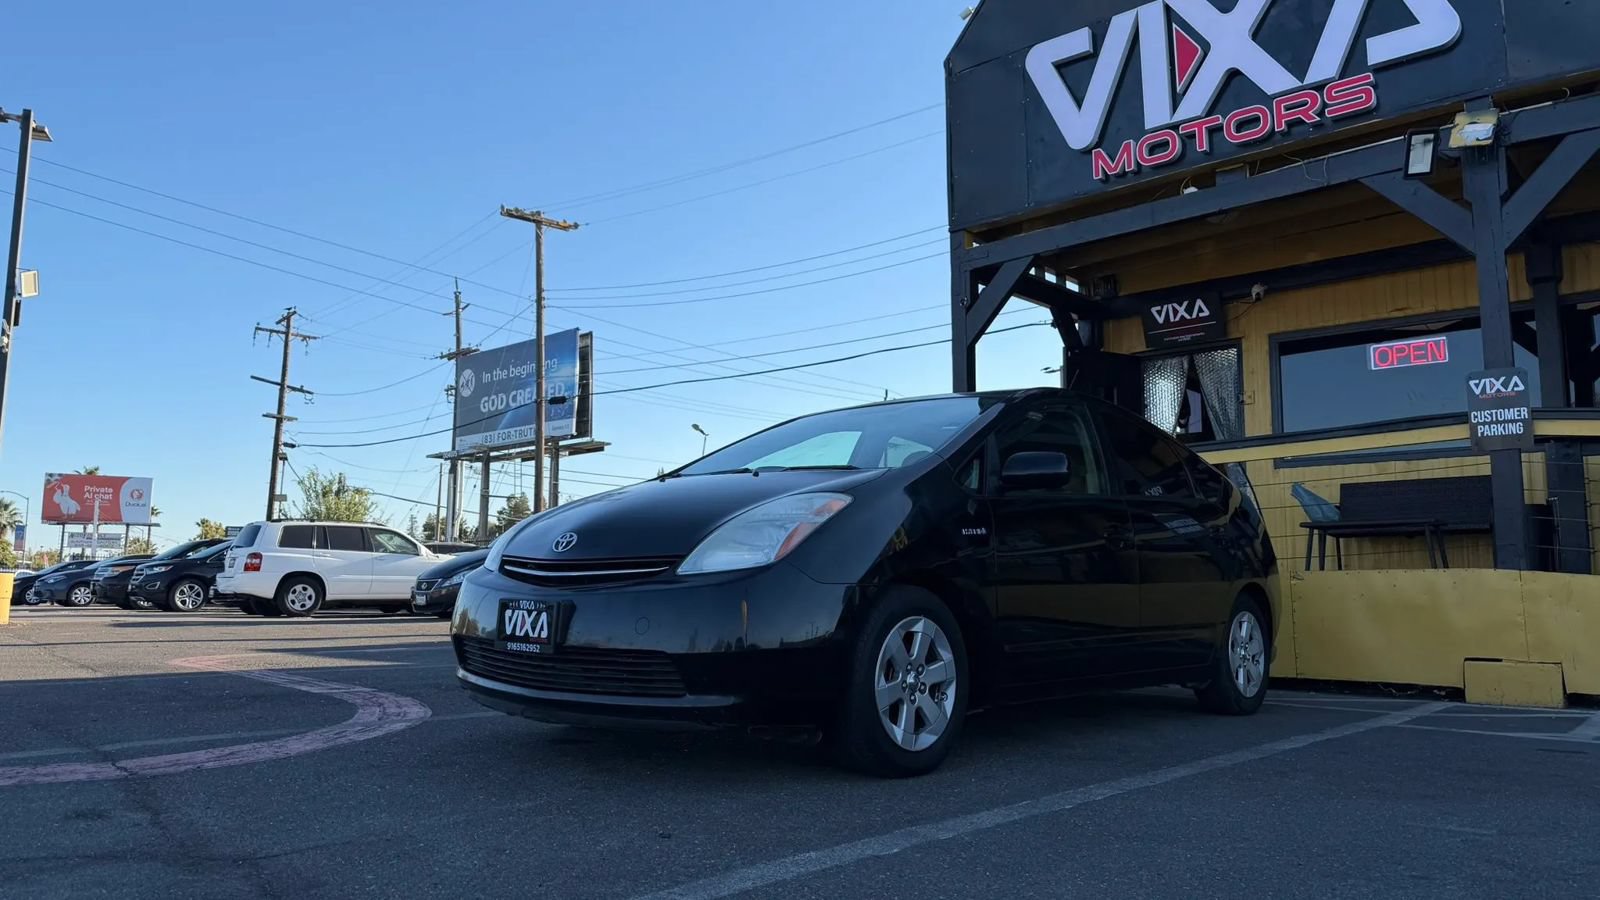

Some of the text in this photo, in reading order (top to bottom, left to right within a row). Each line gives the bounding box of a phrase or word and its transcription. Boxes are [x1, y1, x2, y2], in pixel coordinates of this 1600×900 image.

[1025, 0, 1463, 150] VIXA
[1092, 72, 1376, 181] MOTORS
[1150, 298, 1210, 324] VIXA
[1374, 339, 1445, 368] OPEN
[482, 358, 557, 383] In the beginng
[1469, 375, 1525, 395] VIXA
[480, 393, 507, 413] GOD
[1471, 407, 1528, 423] CUSTOMER
[1477, 422, 1524, 437] PARKING
[84, 485, 114, 494] Private
[94, 493, 113, 501] chat
[505, 609, 548, 638] VIXA
